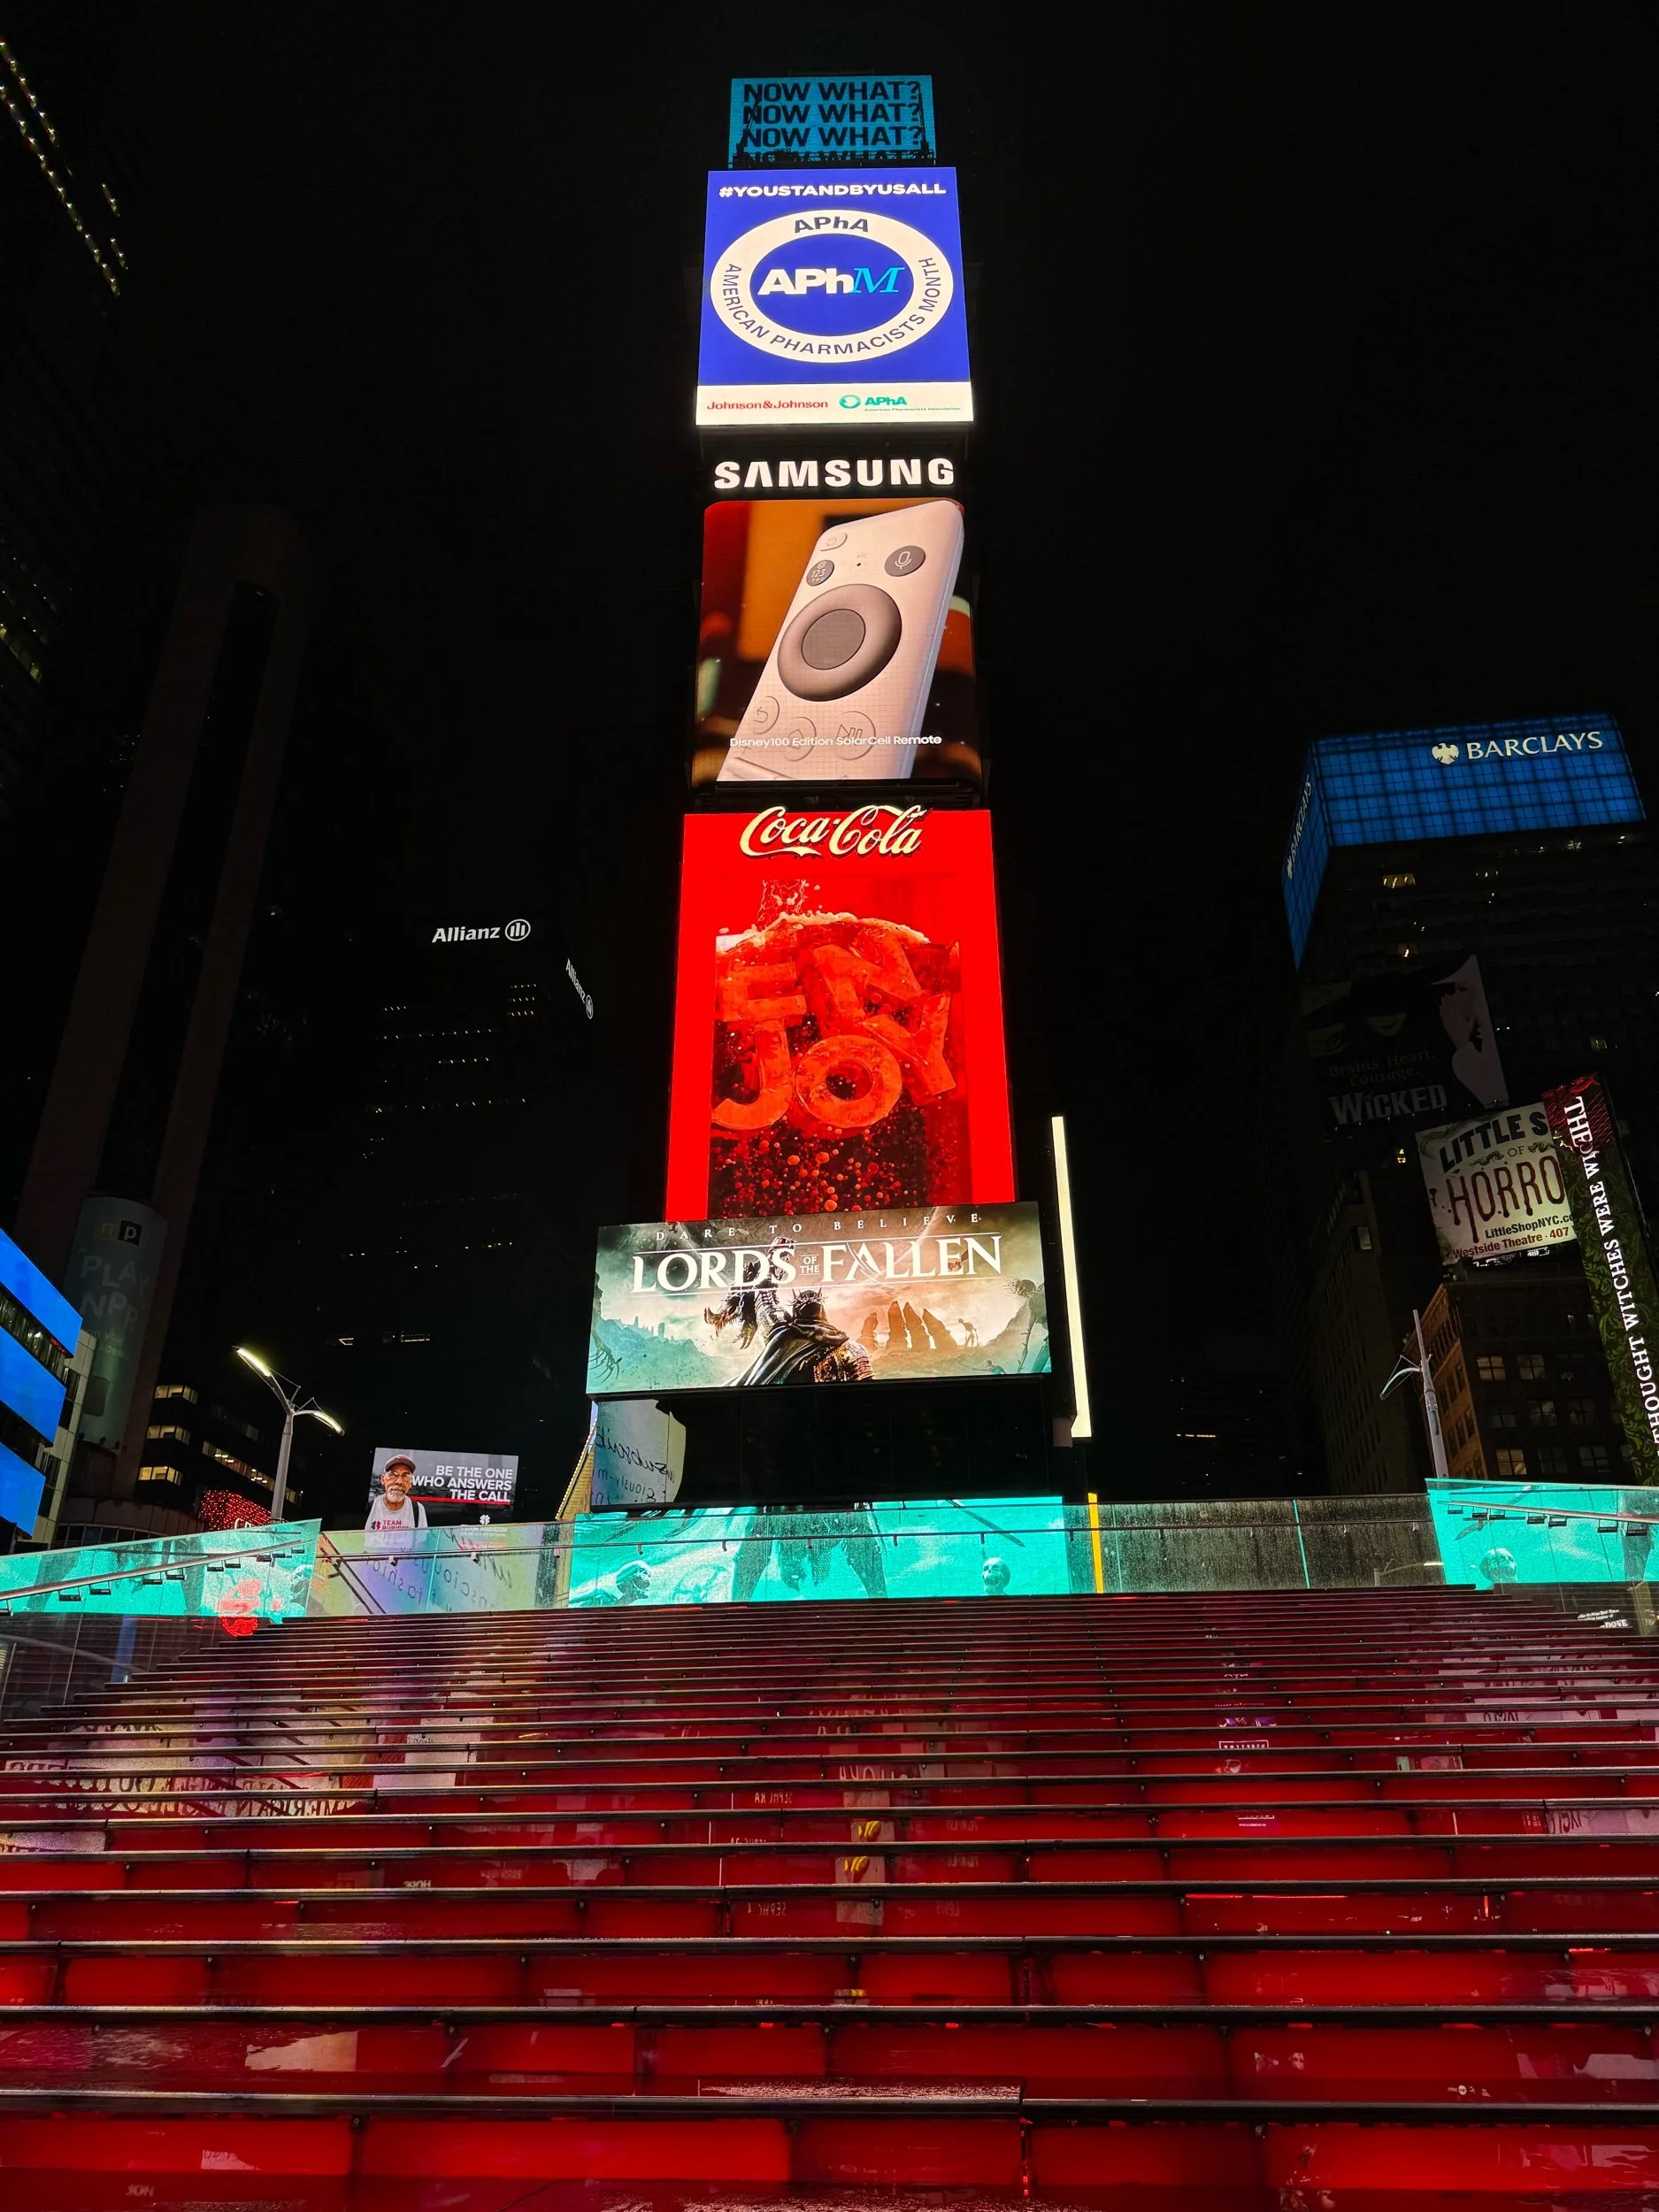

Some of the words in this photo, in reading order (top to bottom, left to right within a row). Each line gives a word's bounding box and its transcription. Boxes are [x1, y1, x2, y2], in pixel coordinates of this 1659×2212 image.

[743, 82, 810, 102] NOW
[818, 81, 922, 101] WHAT?
[743, 104, 810, 124] NOW
[818, 103, 921, 123] WHAT?
[742, 127, 810, 147] NOW
[818, 126, 923, 146] WHAT?
[718, 182, 947, 197] #YOUSTANDBYUSALL
[795, 216, 869, 234] APhA
[757, 266, 905, 296] APhM
[722, 263, 770, 339] AMERICAN
[769, 313, 926, 355] PHARMACISTS
[918, 257, 941, 312] MONTH
[707, 399, 828, 411] Johnson&Johnson
[864, 396, 908, 406] APhA
[714, 457, 954, 489] SAMSUNG
[729, 737, 790, 749] Disney100
[794, 736, 833, 746] Edition
[893, 735, 942, 745] Remote
[1466, 731, 1603, 760] BARCLAYS
[740, 804, 927, 857] Coca-Cola
[432, 926, 501, 943] Allianz
[565, 957, 586, 1003] Allianz
[1564, 1096, 1594, 1148] THE
[1439, 1114, 1525, 1173] LITTLE
[1507, 1146, 1525, 1157] OF
[1589, 1180, 1616, 1236] WERE
[656, 1228, 735, 1240] DARE
[769, 1223, 803, 1234] TO
[833, 1213, 979, 1231] BELIEVE
[1453, 1240, 1500, 1260] Westside
[1503, 1231, 1543, 1248] Theatre
[1549, 1226, 1570, 1240] 407
[800, 1264, 820, 1274] THE
[803, 1256, 817, 1265] OF
[820, 1235, 1002, 1283] FALLEN
[630, 1247, 796, 1294] LORDS
[1603, 1239, 1640, 1331] WITCHES
[435, 1464, 454, 1477] BE
[457, 1466, 482, 1478] THE
[485, 1468, 513, 1479] ONE
[411, 1475, 444, 1487] WHO
[447, 1478, 512, 1491] ANSWERS
[449, 1488, 475, 1501] THE
[479, 1490, 511, 1502] CALL
